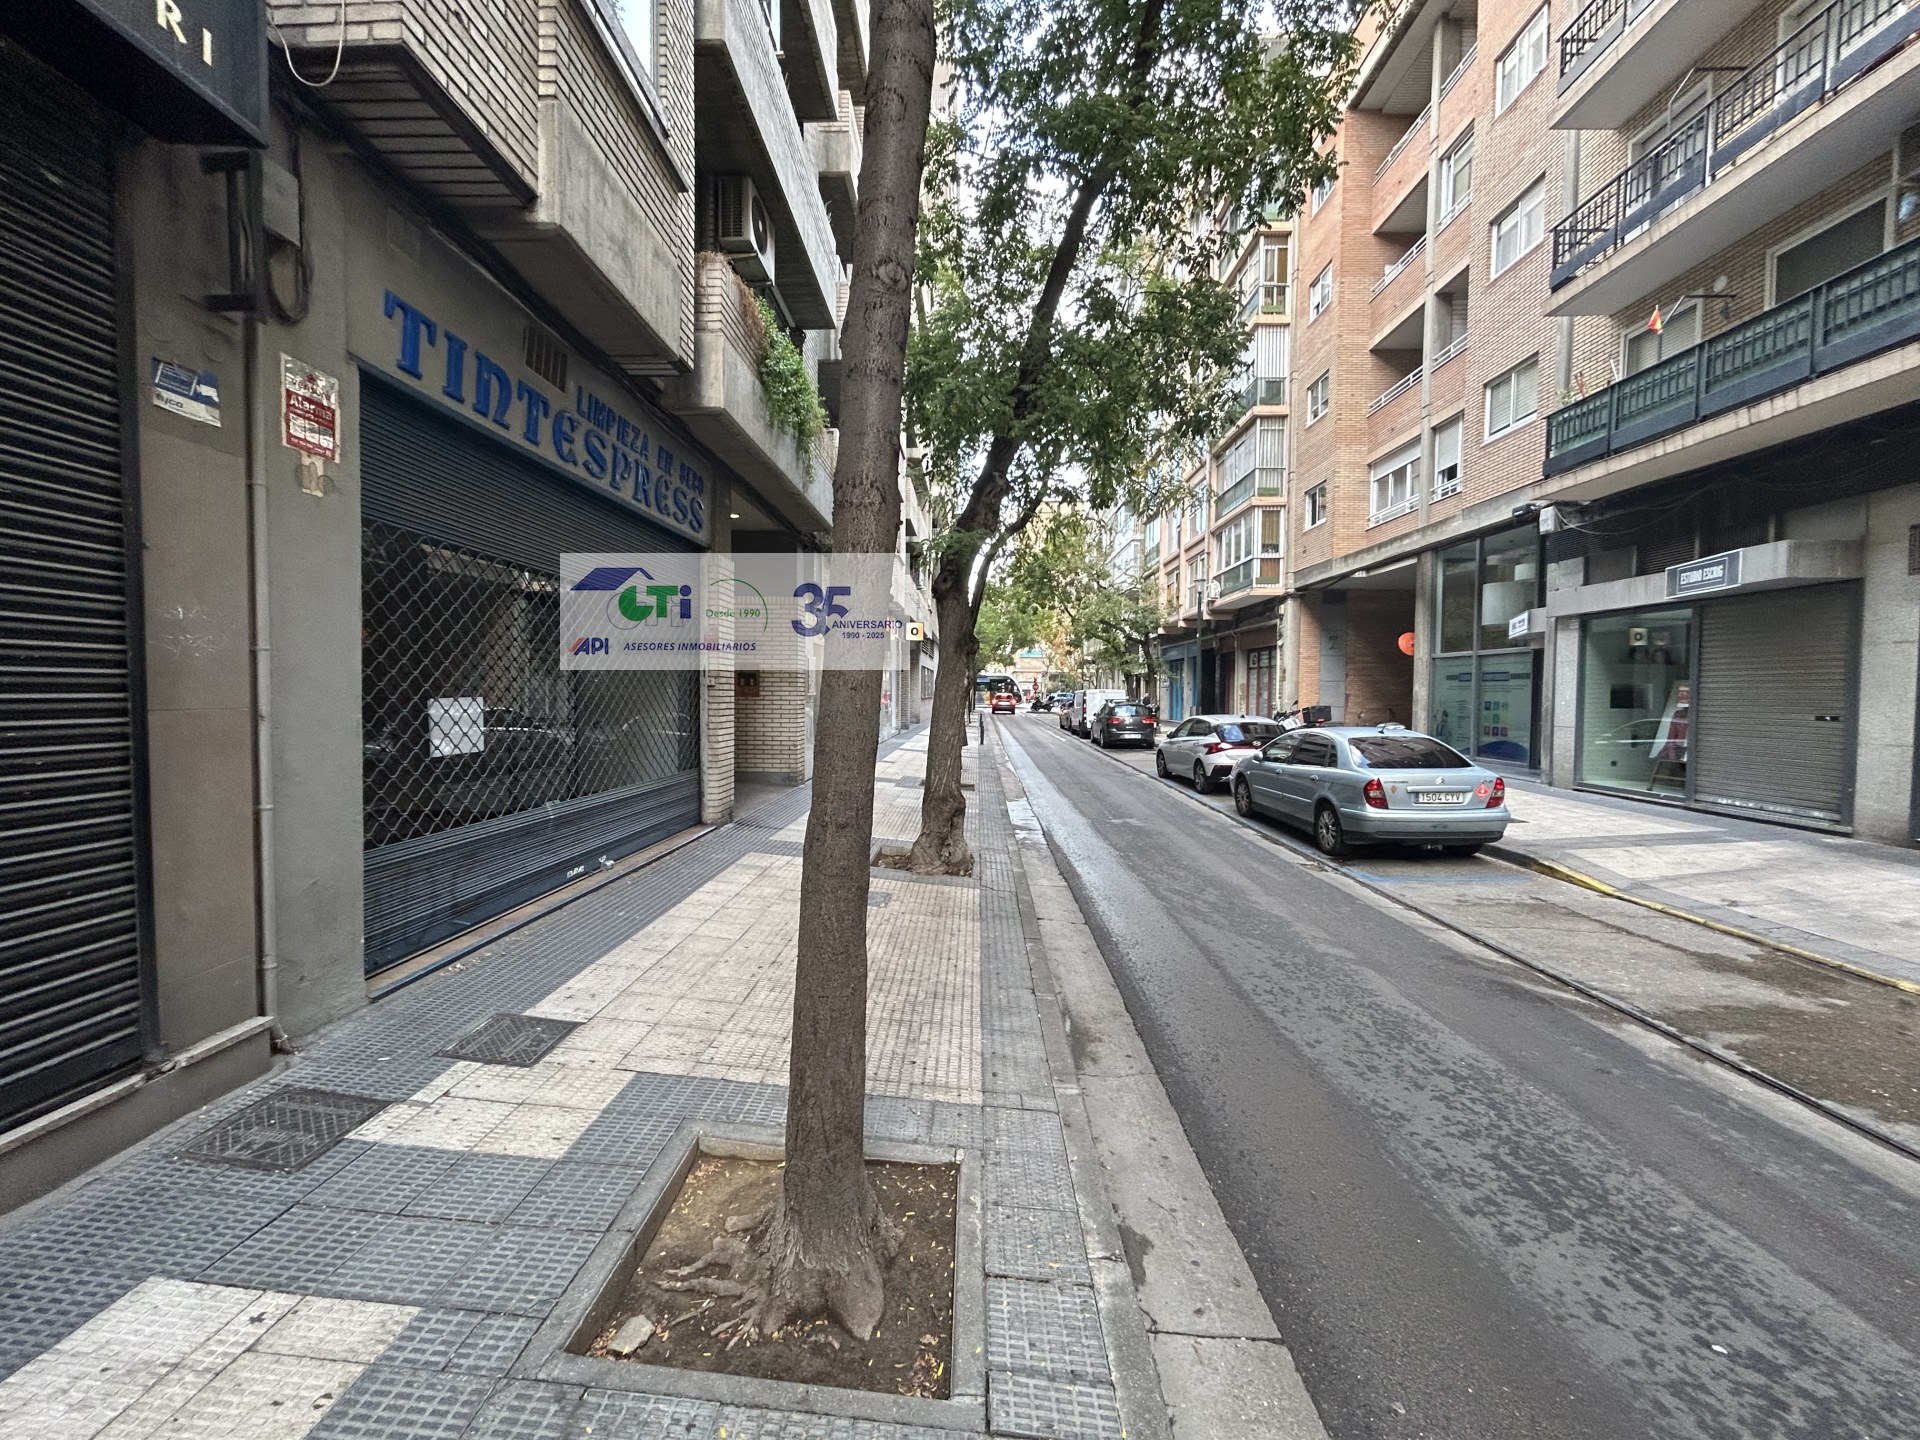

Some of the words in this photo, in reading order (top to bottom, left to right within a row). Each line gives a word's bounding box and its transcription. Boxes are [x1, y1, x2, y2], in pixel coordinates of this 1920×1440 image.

[290, 394, 333, 421] Alarma
[384, 289, 705, 533] TINTESPRESS
[576, 385, 649, 461] LIMPIEZA
[658, 445, 674, 477] EN
[1421, 793, 1442, 802] 1504
[1444, 793, 1461, 802] CYV
